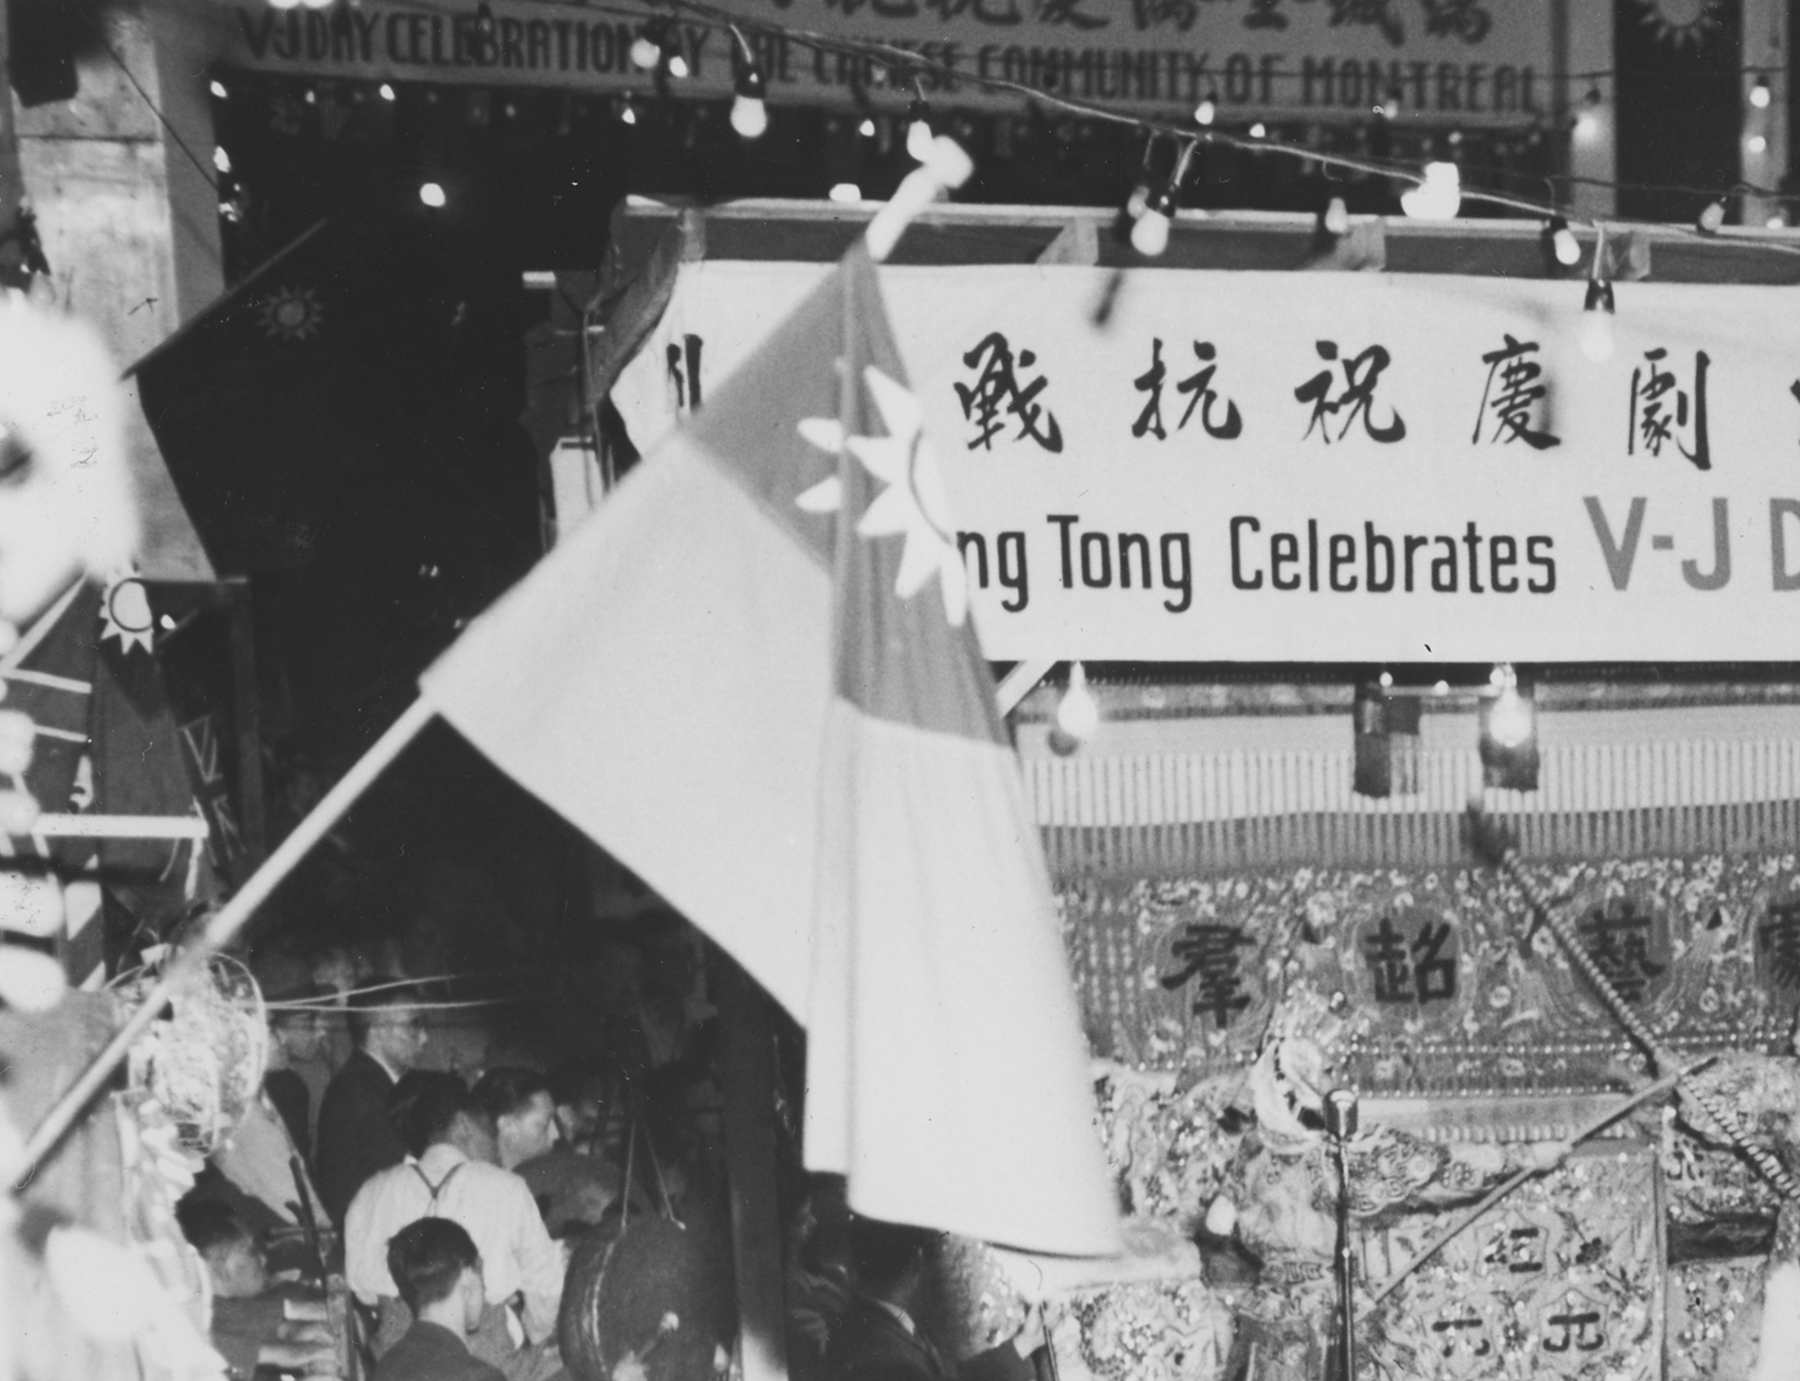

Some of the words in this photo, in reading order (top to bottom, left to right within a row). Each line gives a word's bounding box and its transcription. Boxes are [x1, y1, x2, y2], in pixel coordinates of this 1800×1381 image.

[305, 9, 380, 63] DAY
[978, 44, 1209, 99] COMMUNITY
[1225, 52, 1287, 103] OF
[1303, 54, 1537, 111] MONTREAL
[956, 530, 1029, 613] ng
[1046, 514, 1193, 614] Tong
[1229, 515, 1557, 595] Celebrates
[1583, 496, 1731, 591] V-J
